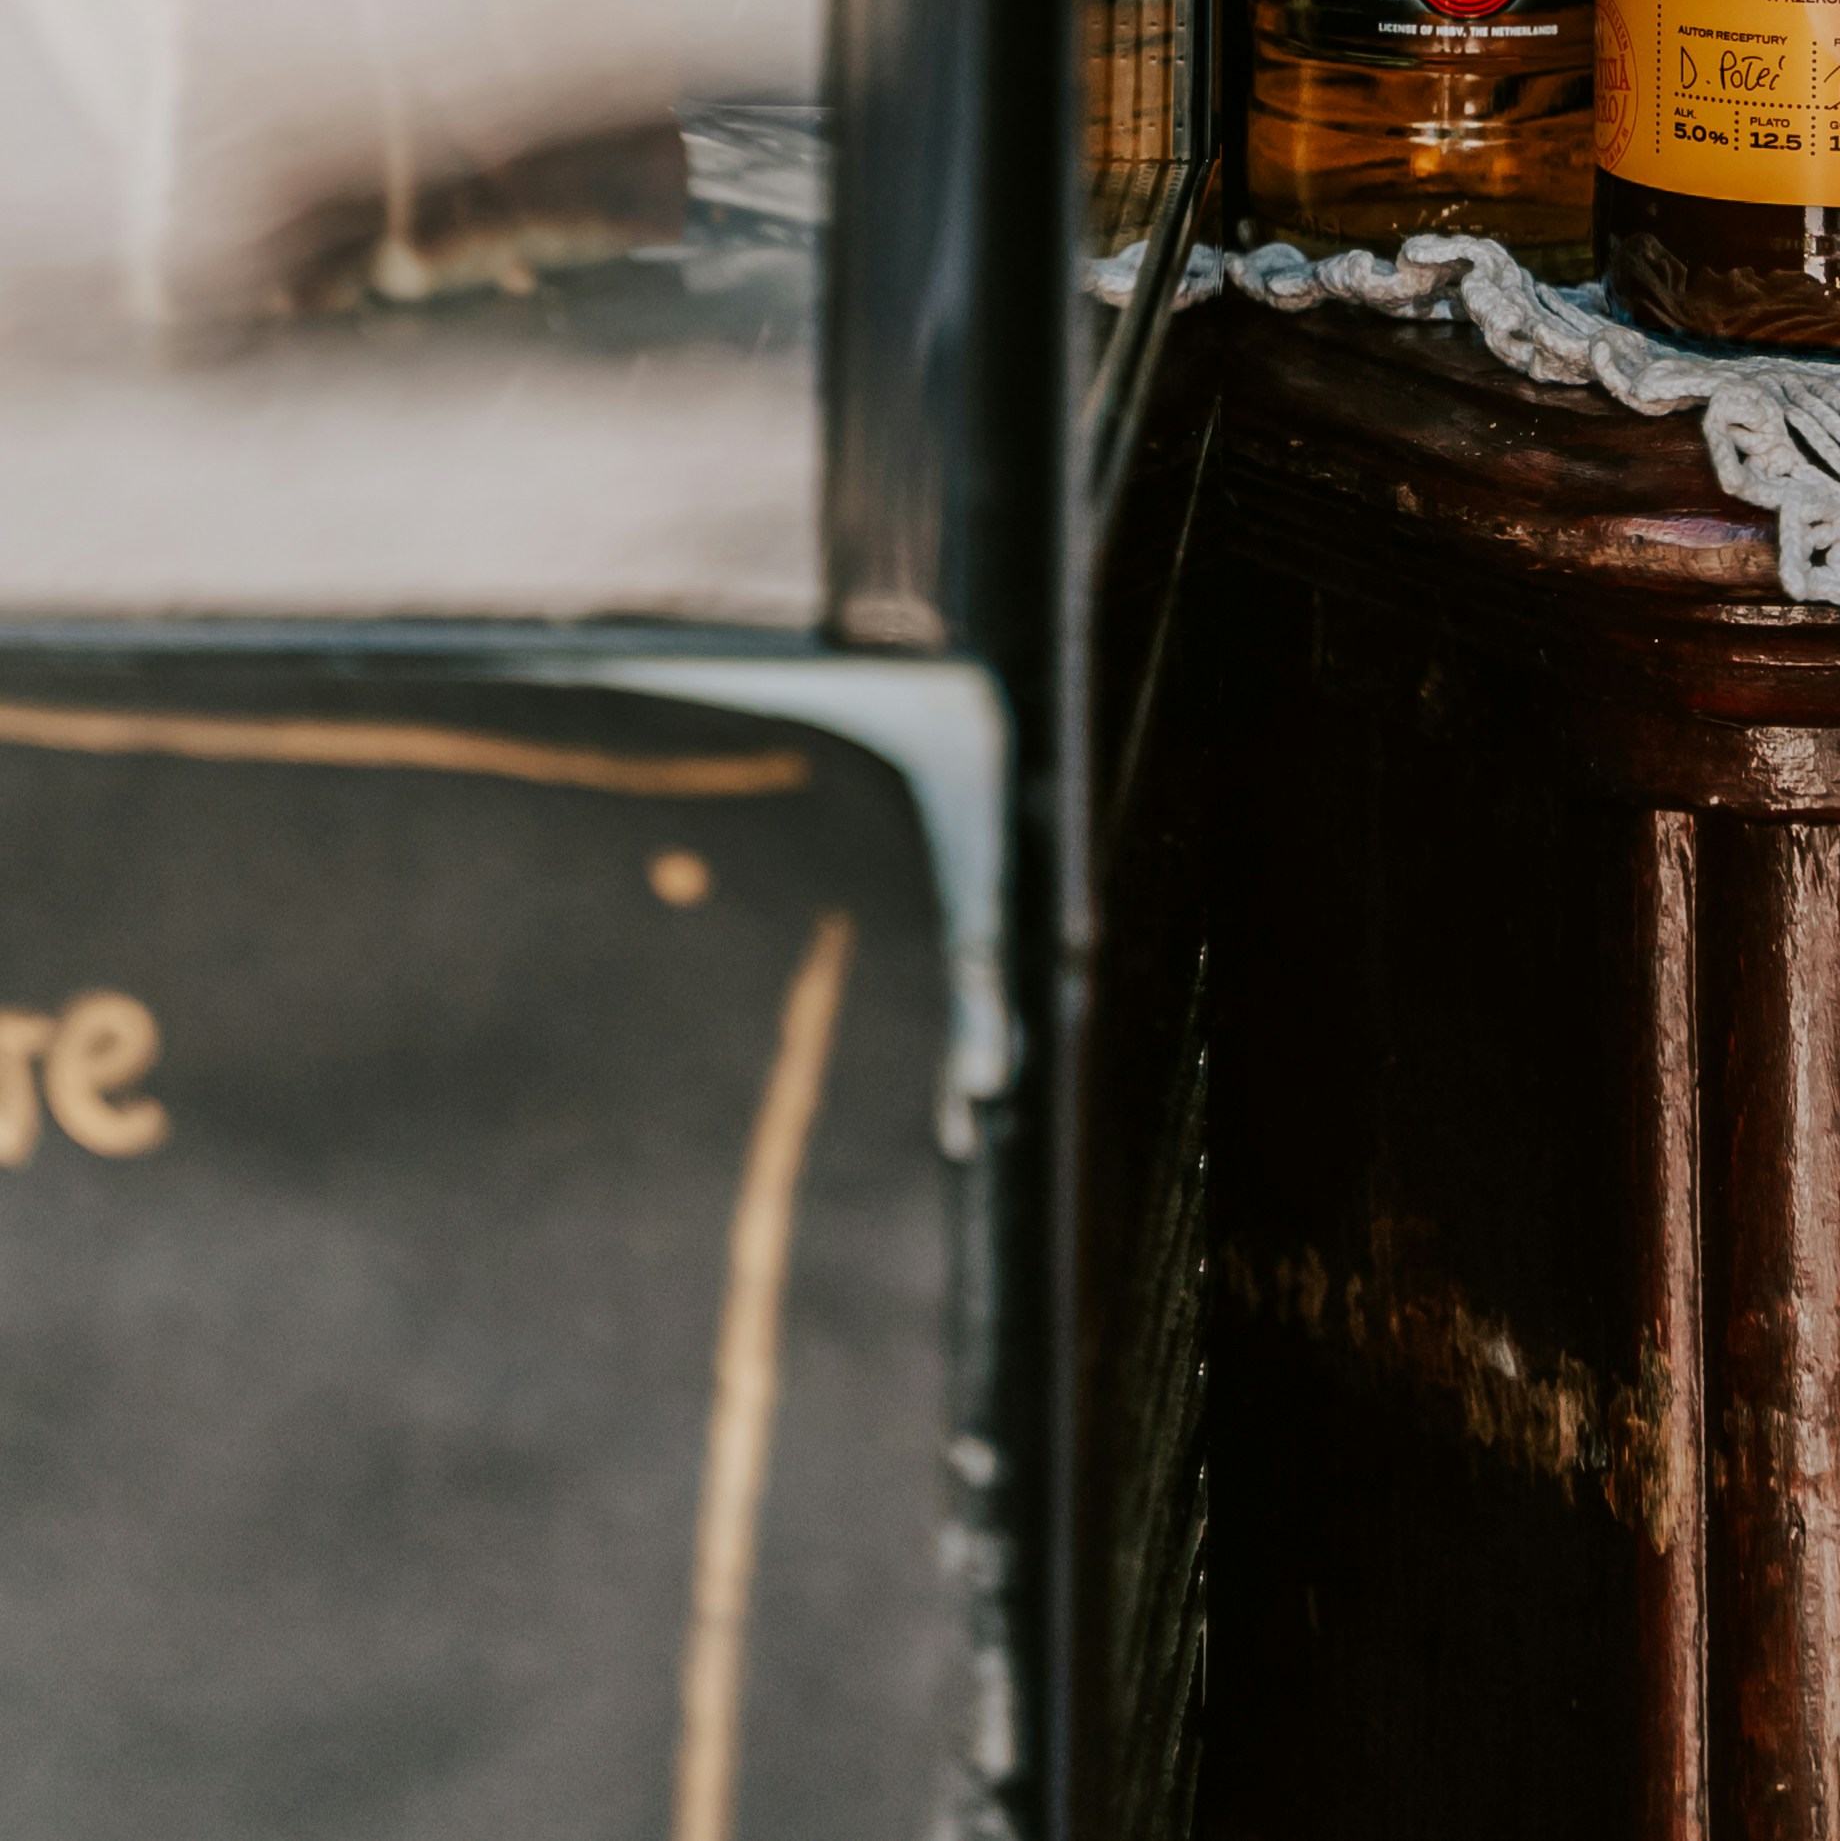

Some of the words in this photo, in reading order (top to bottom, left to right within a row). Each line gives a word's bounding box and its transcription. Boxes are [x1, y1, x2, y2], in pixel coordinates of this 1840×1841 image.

[1378, 22, 1417, 35] LICENSE
[1420, 24, 1434, 35] OF
[1469, 26, 1488, 37] THE
[1491, 24, 1558, 37] NETHERLANDS
[1678, 25, 1714, 39] AUTOR
[1716, 29, 1788, 46] RECEPTURY
[1674, 107, 1697, 119] ALK.
[1750, 116, 1791, 129] PLATO
[1674, 122, 1729, 146] 5.0%
[1750, 131, 1803, 151] 12.5
